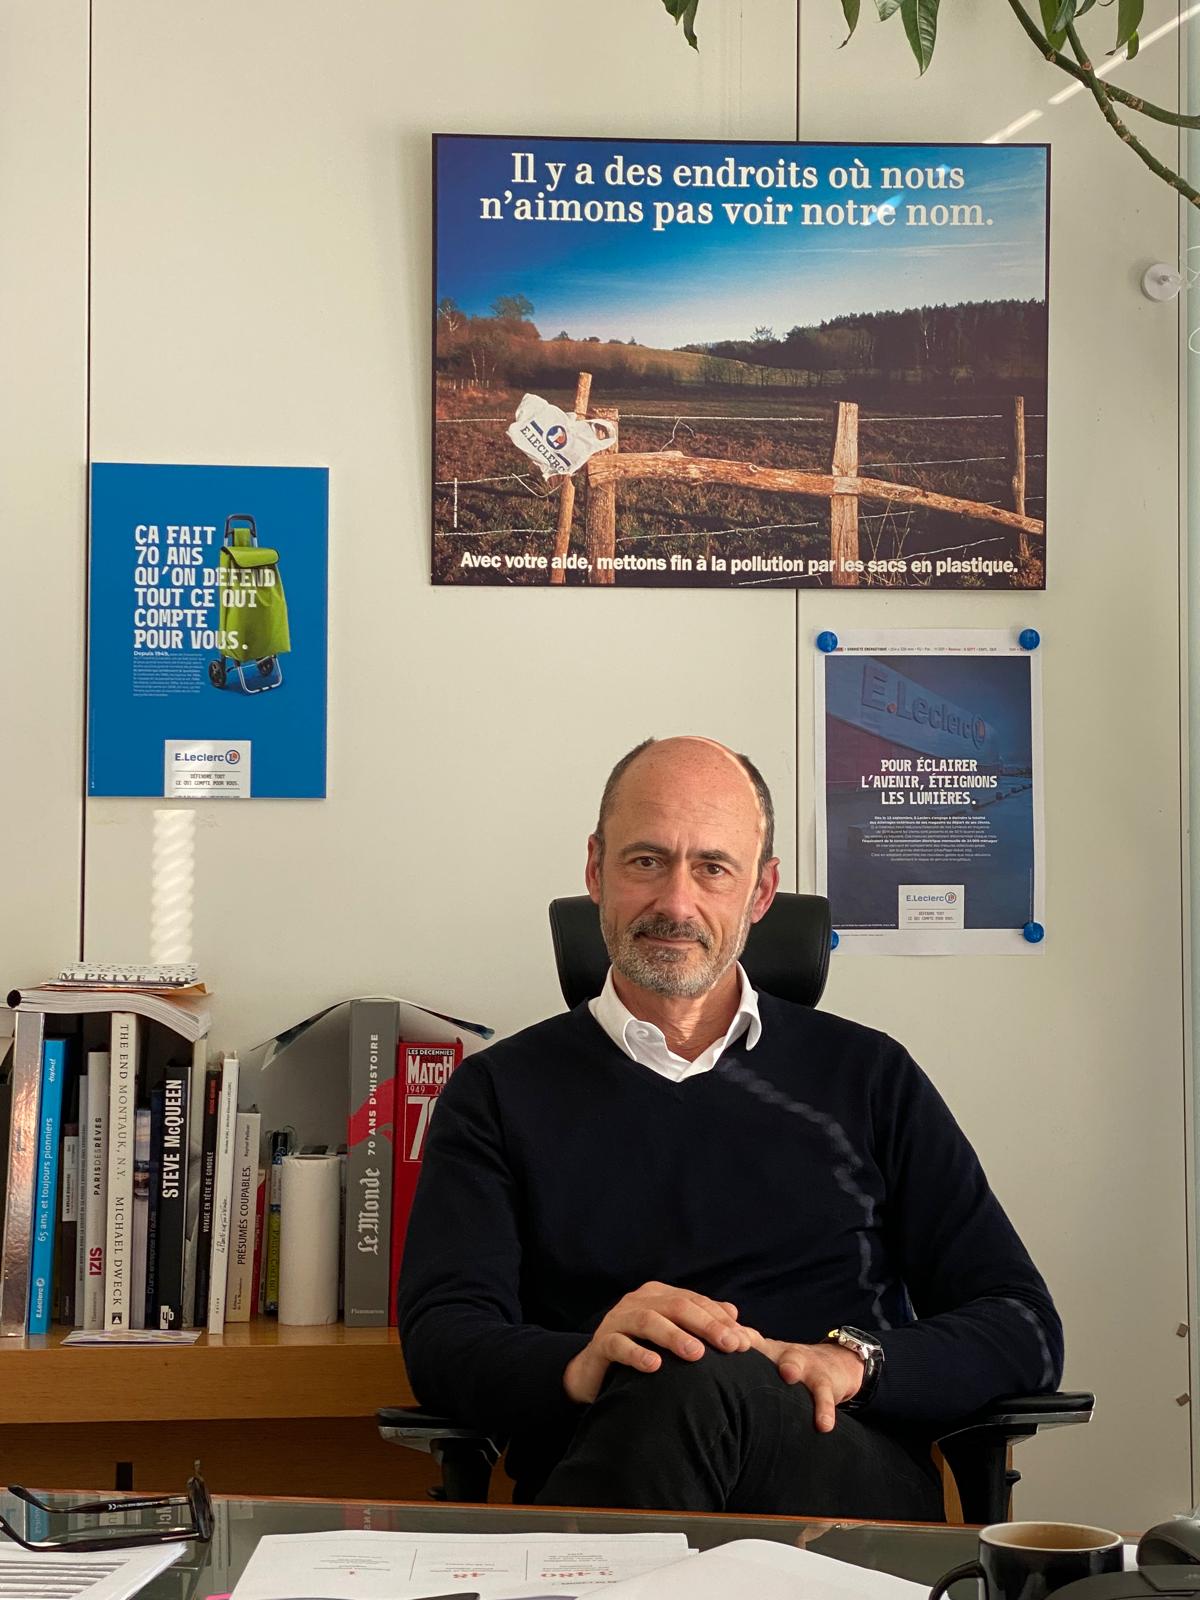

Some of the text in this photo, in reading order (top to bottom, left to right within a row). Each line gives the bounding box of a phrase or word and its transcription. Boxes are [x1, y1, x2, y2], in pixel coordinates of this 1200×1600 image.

[511, 152, 965, 191] Il y a des endroits où nous
[652, 201, 714, 231] pas
[721, 196, 793, 225] voir
[801, 199, 896, 226] notre
[905, 204, 994, 226] nom.
[166, 526, 216, 545] FAIT
[135, 546, 203, 565] 70 ANS
[460, 552, 501, 569] Avec
[505, 552, 547, 569] votre
[596, 555, 667, 571] mettons
[670, 555, 692, 571] fin
[696, 555, 707, 571] à
[711, 556, 727, 571] la
[730, 556, 804, 574] pollution
[808, 559, 836, 574] par
[840, 557, 863, 571] les
[867, 559, 906, 571] sacs
[910, 560, 932, 572] en
[935, 557, 1018, 575] plastique.
[134, 566, 196, 586] QU'ON
[134, 588, 257, 608] TOUT CE QUI
[134, 608, 208, 628] COMPTE
[133, 629, 248, 650] POUR VOUS.
[861, 662, 971, 740] E.Leclerc
[175, 752, 225, 762] E.Leclerc
[880, 756, 978, 772] POUR ÉCLAIRER
[861, 773, 998, 790] L'AVENIR, ÉTEIGNONS
[881, 789, 976, 805] LES LUMIÈRES.
[906, 894, 945, 902] E.Leclerc
[407, 1055, 453, 1085] MATCH
[115, 1024, 129, 1181] THE END MONTAUK, N.Y.
[367, 1034, 379, 1156] 70 ANS D'HISTOIRE
[406, 1085, 426, 1094] 1949
[162, 1079, 185, 1199] STEVE McQUEEN
[38, 1117, 54, 1242] 65 ans, et toujours pionniers
[202, 1151, 214, 1233] VOYAGE EN TÊTE DE GONDOLE
[356, 1167, 381, 1255] Le Monde
[112, 1196, 124, 1306] MICHAEL DWECK
[236, 1219, 249, 1265] PRÉSUMÉS
[89, 1247, 103, 1276] IZIS
[35, 1287, 45, 1318] E.Leclerc
